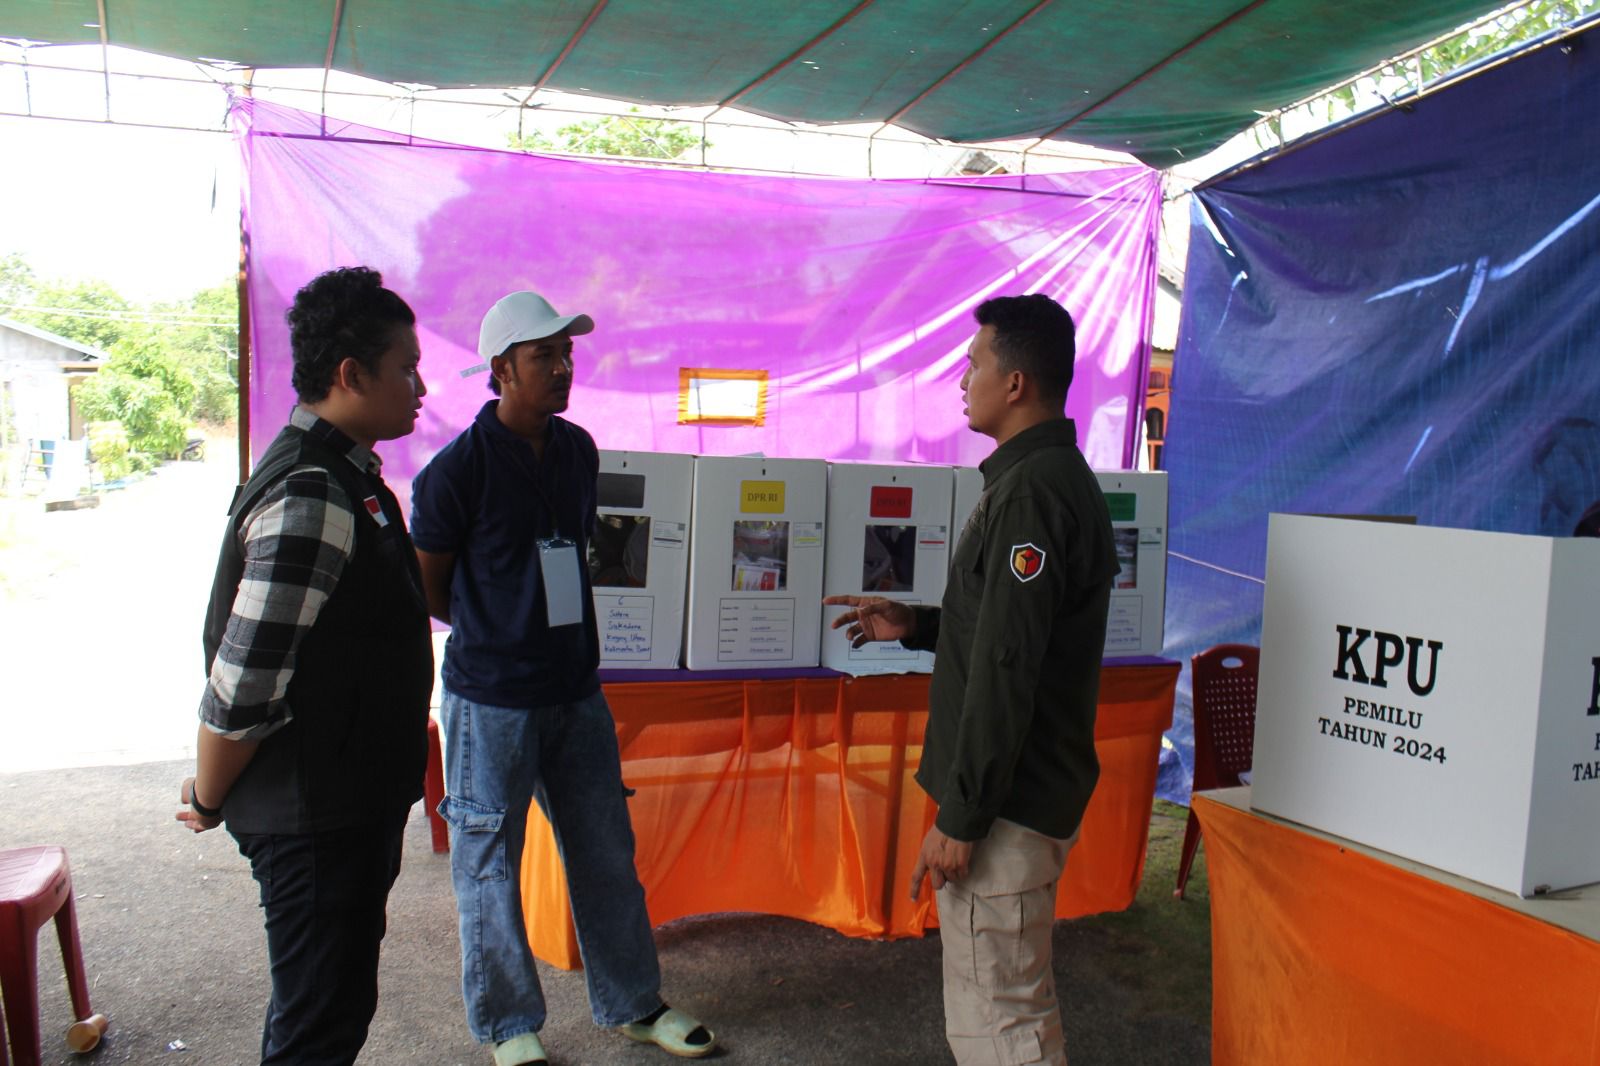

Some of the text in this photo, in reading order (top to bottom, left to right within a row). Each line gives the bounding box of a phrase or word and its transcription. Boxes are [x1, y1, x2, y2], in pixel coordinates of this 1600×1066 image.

[747, 493, 766, 502] DPR
[1332, 624, 1443, 696] KPU
[1343, 696, 1423, 729] PEMILU
[1318, 717, 1447, 764] TAHUN 2024
